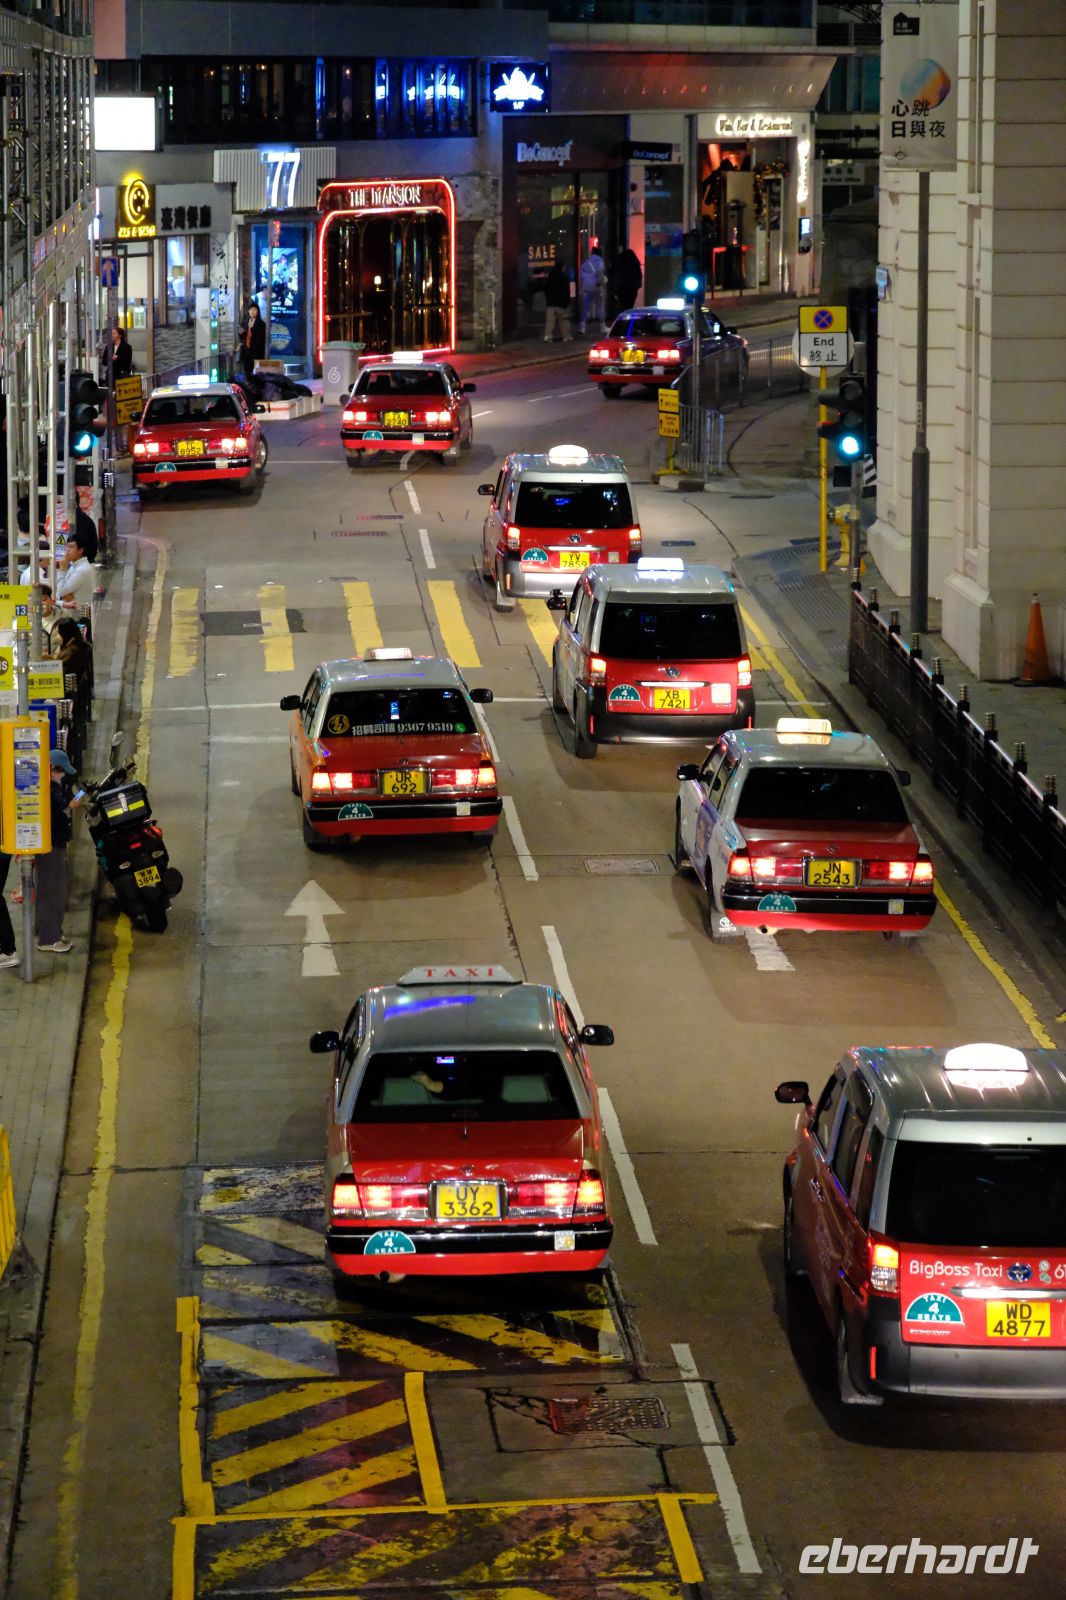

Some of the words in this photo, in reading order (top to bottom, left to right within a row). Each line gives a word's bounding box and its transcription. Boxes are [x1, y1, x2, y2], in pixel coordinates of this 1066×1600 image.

[891, 99, 930, 118] 心跳
[891, 120, 946, 138] 日與夜
[517, 140, 573, 166] BoConcept
[264, 152, 300, 208] 77
[348, 187, 369, 207] THE
[371, 184, 422, 206] MANSION
[528, 244, 556, 259] SALE
[814, 337, 835, 346] End
[809, 349, 838, 362] 終止
[16, 605, 27, 616] 13
[665, 689, 680, 699] XB
[659, 698, 686, 708] 7421
[395, 771, 412, 783] UR
[391, 782, 417, 794] 692
[351, 806, 359, 814] 4
[823, 862, 842, 874] JN
[813, 873, 850, 885] 2543
[773, 898, 781, 906] 4
[424, 967, 493, 978] TAXI
[456, 1186, 479, 1202] UY
[444, 1201, 495, 1217] 3362
[384, 1237, 394, 1248] 4
[909, 1259, 971, 1280] BigBoss
[974, 1261, 1004, 1278] Taxi
[923, 1295, 946, 1304] TAXI
[928, 1302, 940, 1315] 4
[1006, 1303, 1032, 1320] WD
[917, 1313, 951, 1321] SEATS
[992, 1319, 1046, 1336] 4877
